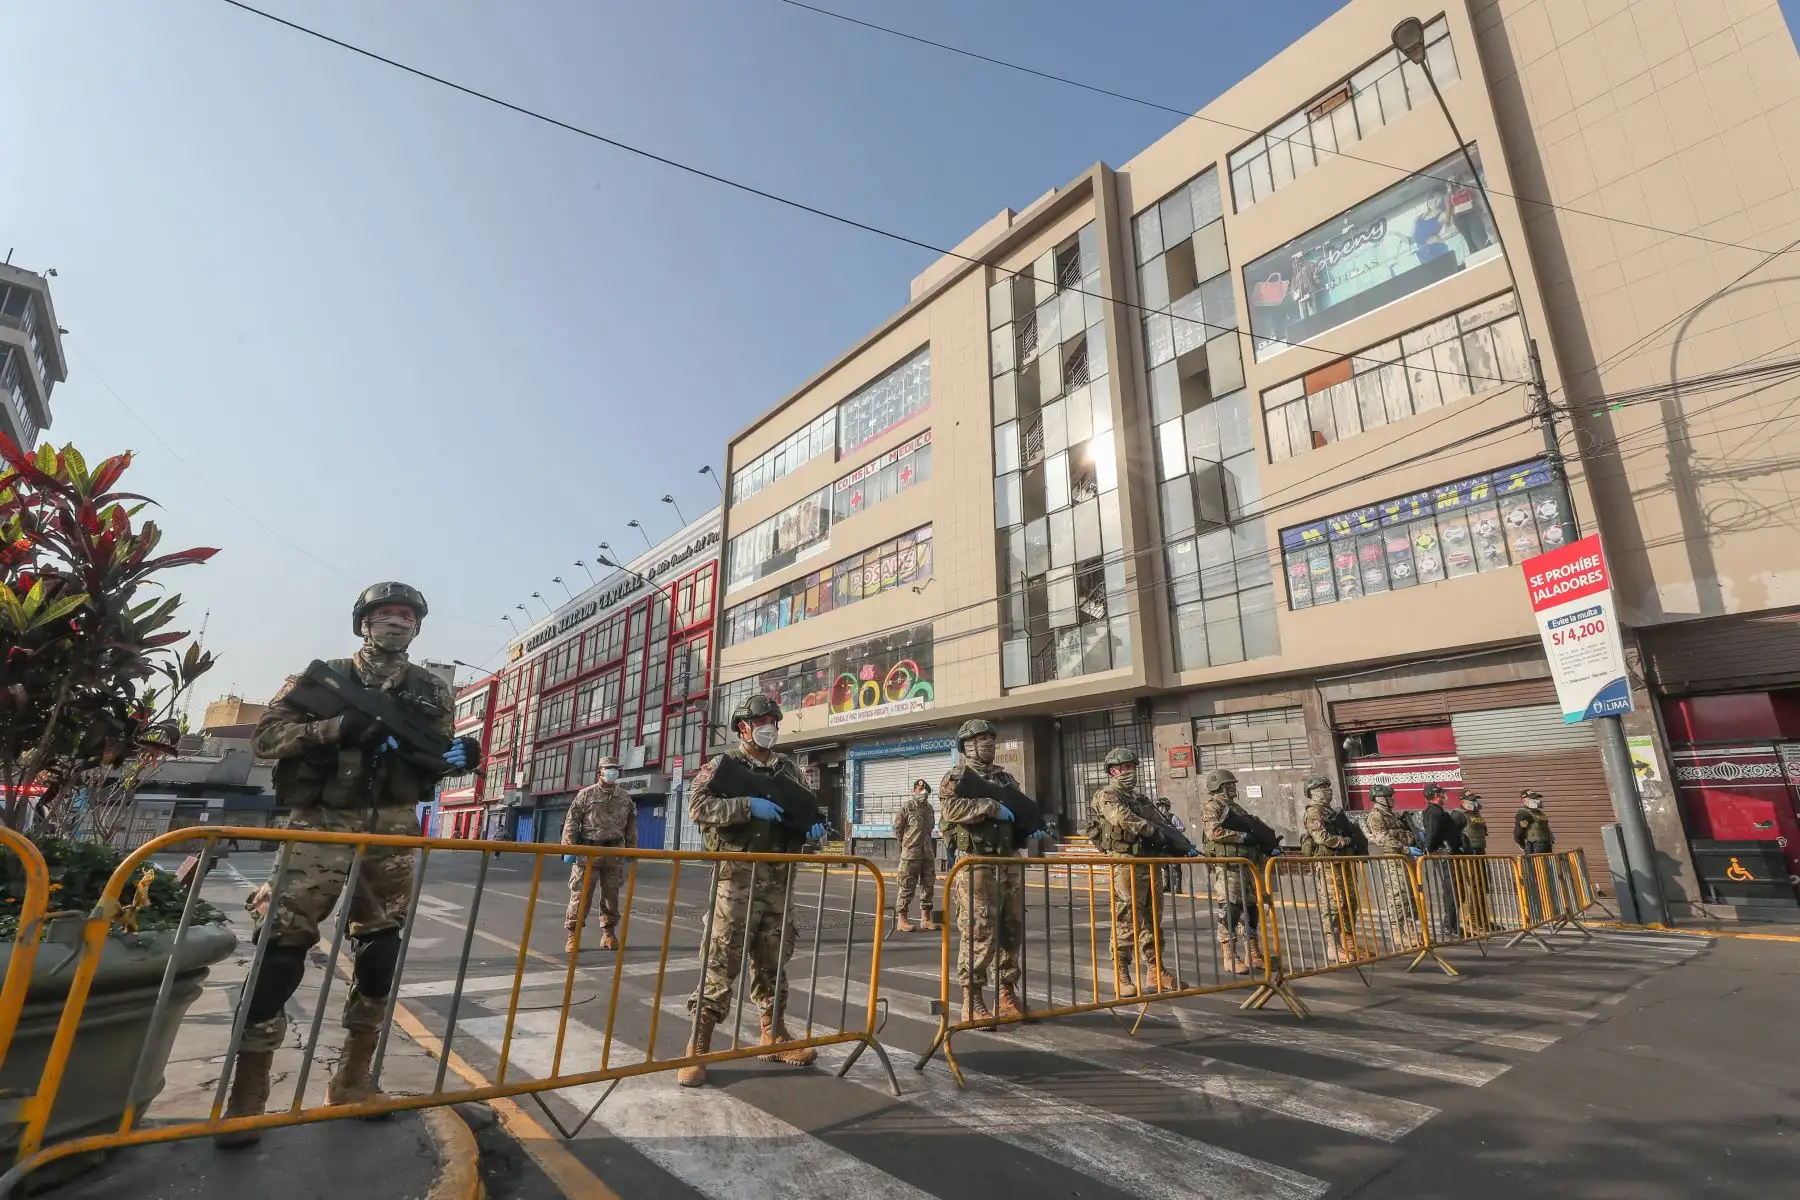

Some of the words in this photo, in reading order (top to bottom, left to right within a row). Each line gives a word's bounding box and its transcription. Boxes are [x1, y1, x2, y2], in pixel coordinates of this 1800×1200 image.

[888, 432, 932, 462] MEDICO
[1328, 504, 1385, 525] PELOTAS
[1394, 475, 1489, 505] DEPORTIVAS
[1530, 575, 1545, 588] SE
[1545, 554, 1600, 581] PROHÍBE
[1533, 570, 1603, 603] JALADORES
[1552, 616, 1570, 628] Evite
[1569, 614, 1577, 623] la
[1577, 608, 1599, 621] multa
[1552, 631, 1565, 646] S/
[1568, 620, 1605, 643] 4,200
[1606, 700, 1629, 711] LIMA
